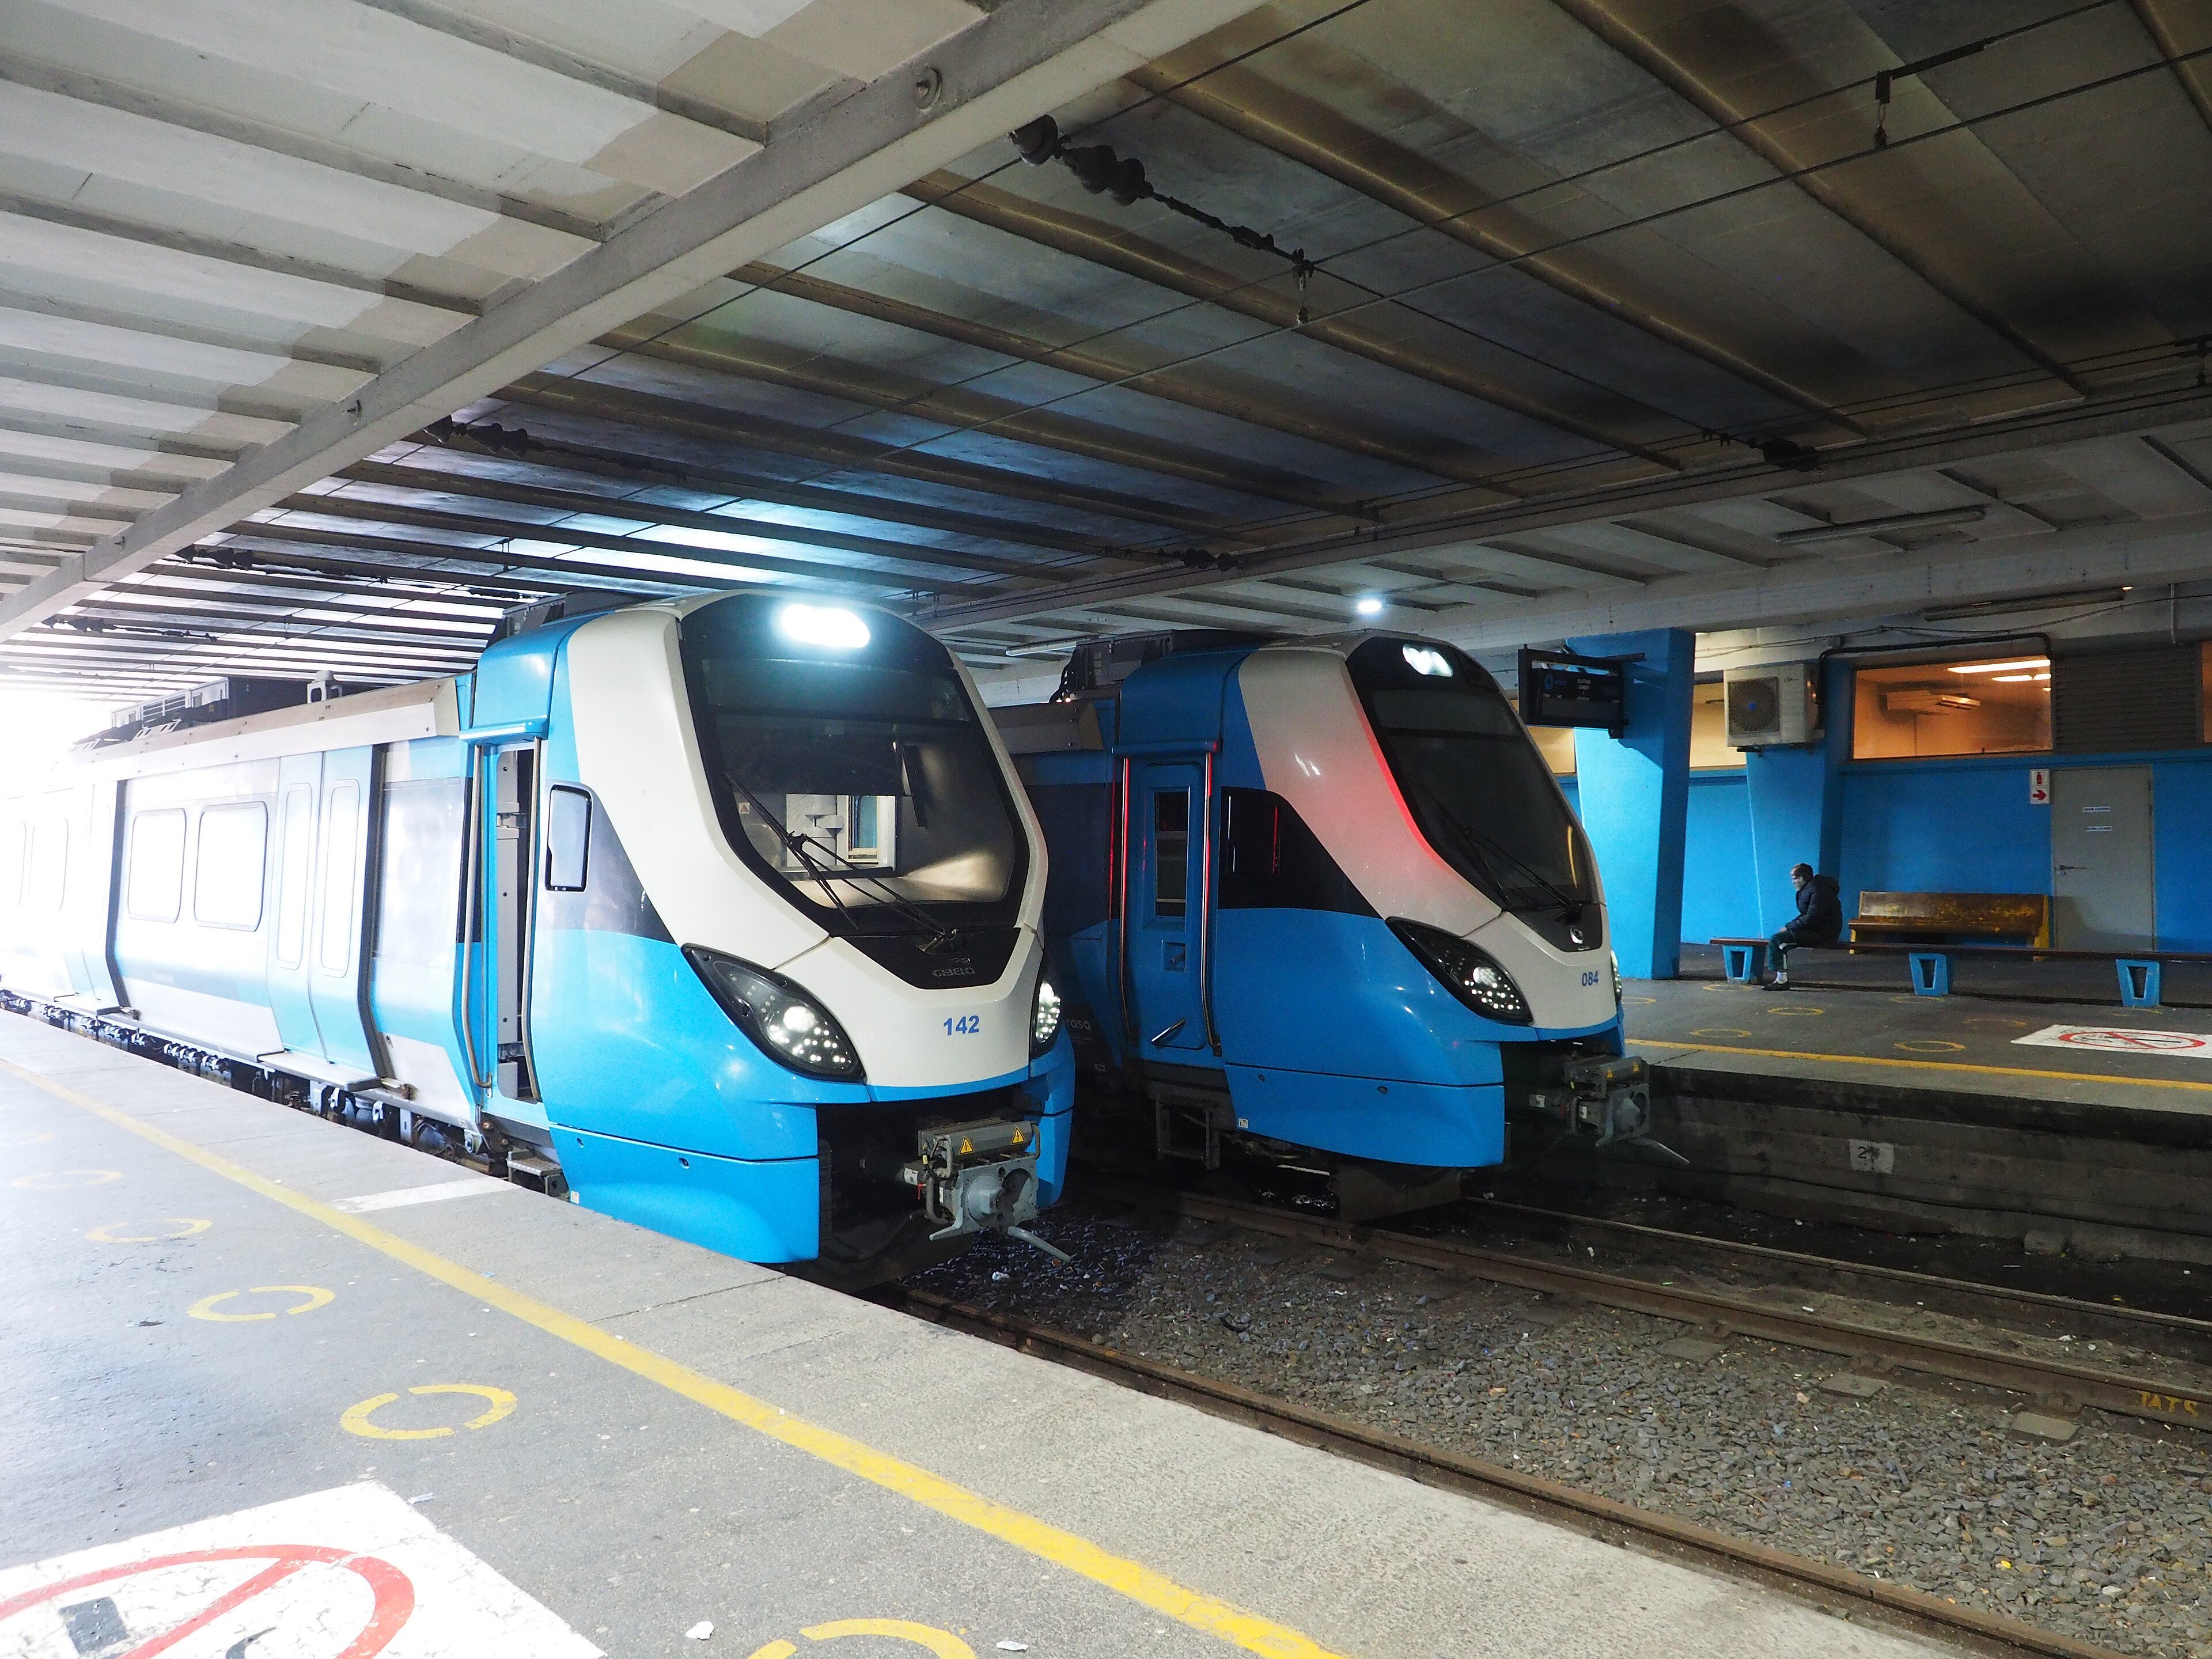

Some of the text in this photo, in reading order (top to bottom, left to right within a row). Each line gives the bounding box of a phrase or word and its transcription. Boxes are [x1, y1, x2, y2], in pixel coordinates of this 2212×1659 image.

[1582, 971, 1599, 987] 084
[943, 1015, 980, 1036] 142
[1063, 1017, 1092, 1031] rasa
